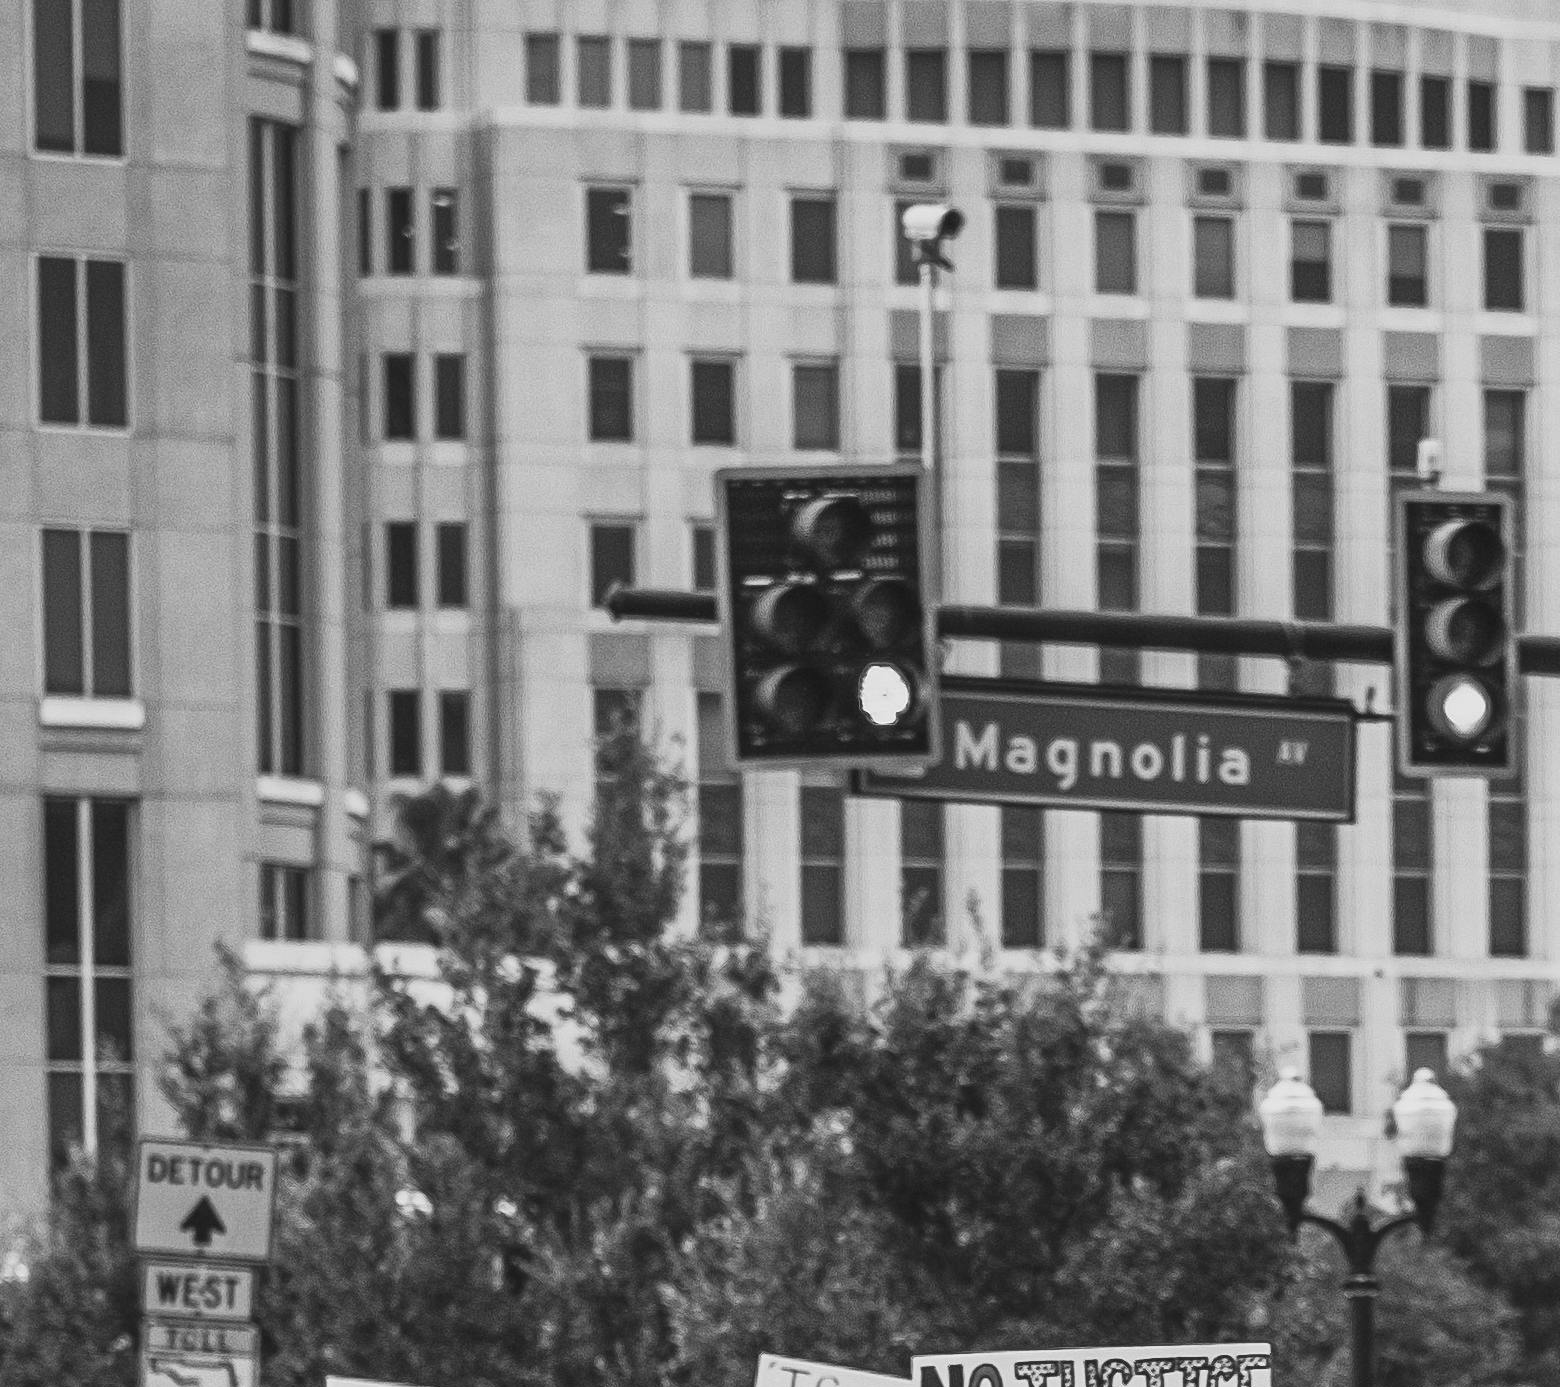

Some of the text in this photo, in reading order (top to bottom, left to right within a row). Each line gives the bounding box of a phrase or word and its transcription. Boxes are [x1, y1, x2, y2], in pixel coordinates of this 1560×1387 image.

[953, 720, 1251, 788] Magnolia
[147, 1154, 265, 1190] DETOUR
[156, 1273, 240, 1309] WEST
